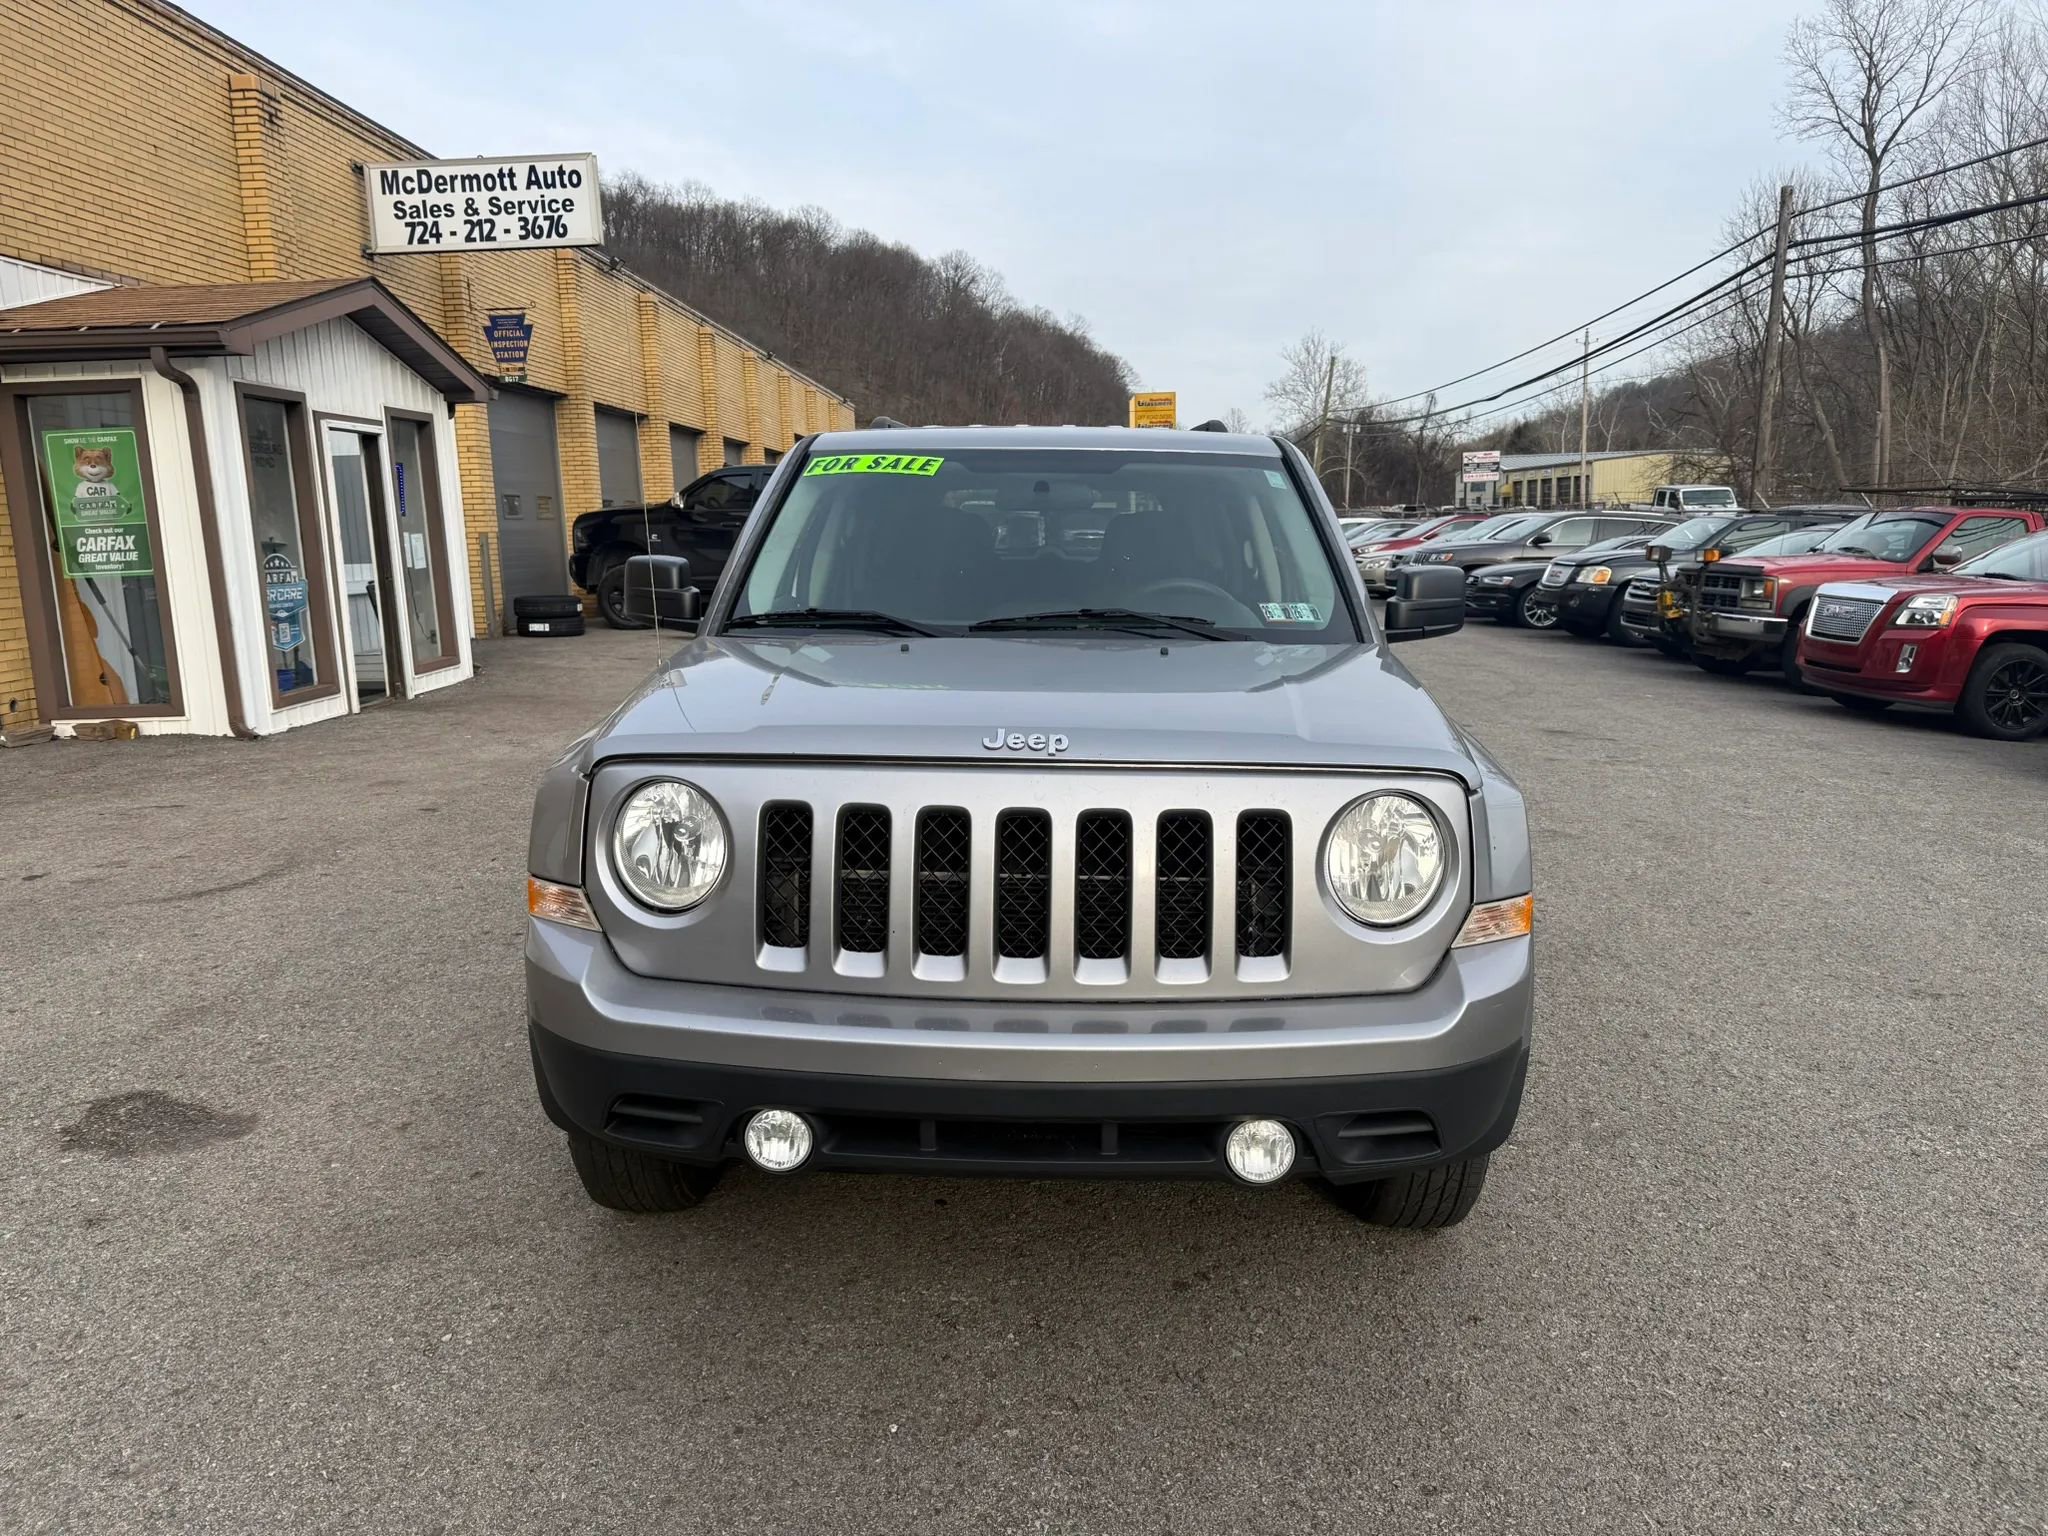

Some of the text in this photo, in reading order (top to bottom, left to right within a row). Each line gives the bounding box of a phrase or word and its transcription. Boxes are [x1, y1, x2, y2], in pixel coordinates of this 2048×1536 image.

[380, 164, 582, 195] McDermott Auto
[393, 195, 575, 220] Sales & Service
[404, 221, 442, 245] 724
[464, 219, 497, 243] 212
[517, 215, 568, 240] 3676
[491, 340, 528, 348] INSPECTION
[807, 456, 938, 474] FOR SALE
[87, 486, 107, 497] CAR
[80, 501, 117, 509] CARFAX
[77, 535, 136, 552] CARFAX
[79, 551, 139, 563] GREAT VALUE
[265, 571, 299, 584] ARFAX
[982, 728, 1069, 756] Jeep
